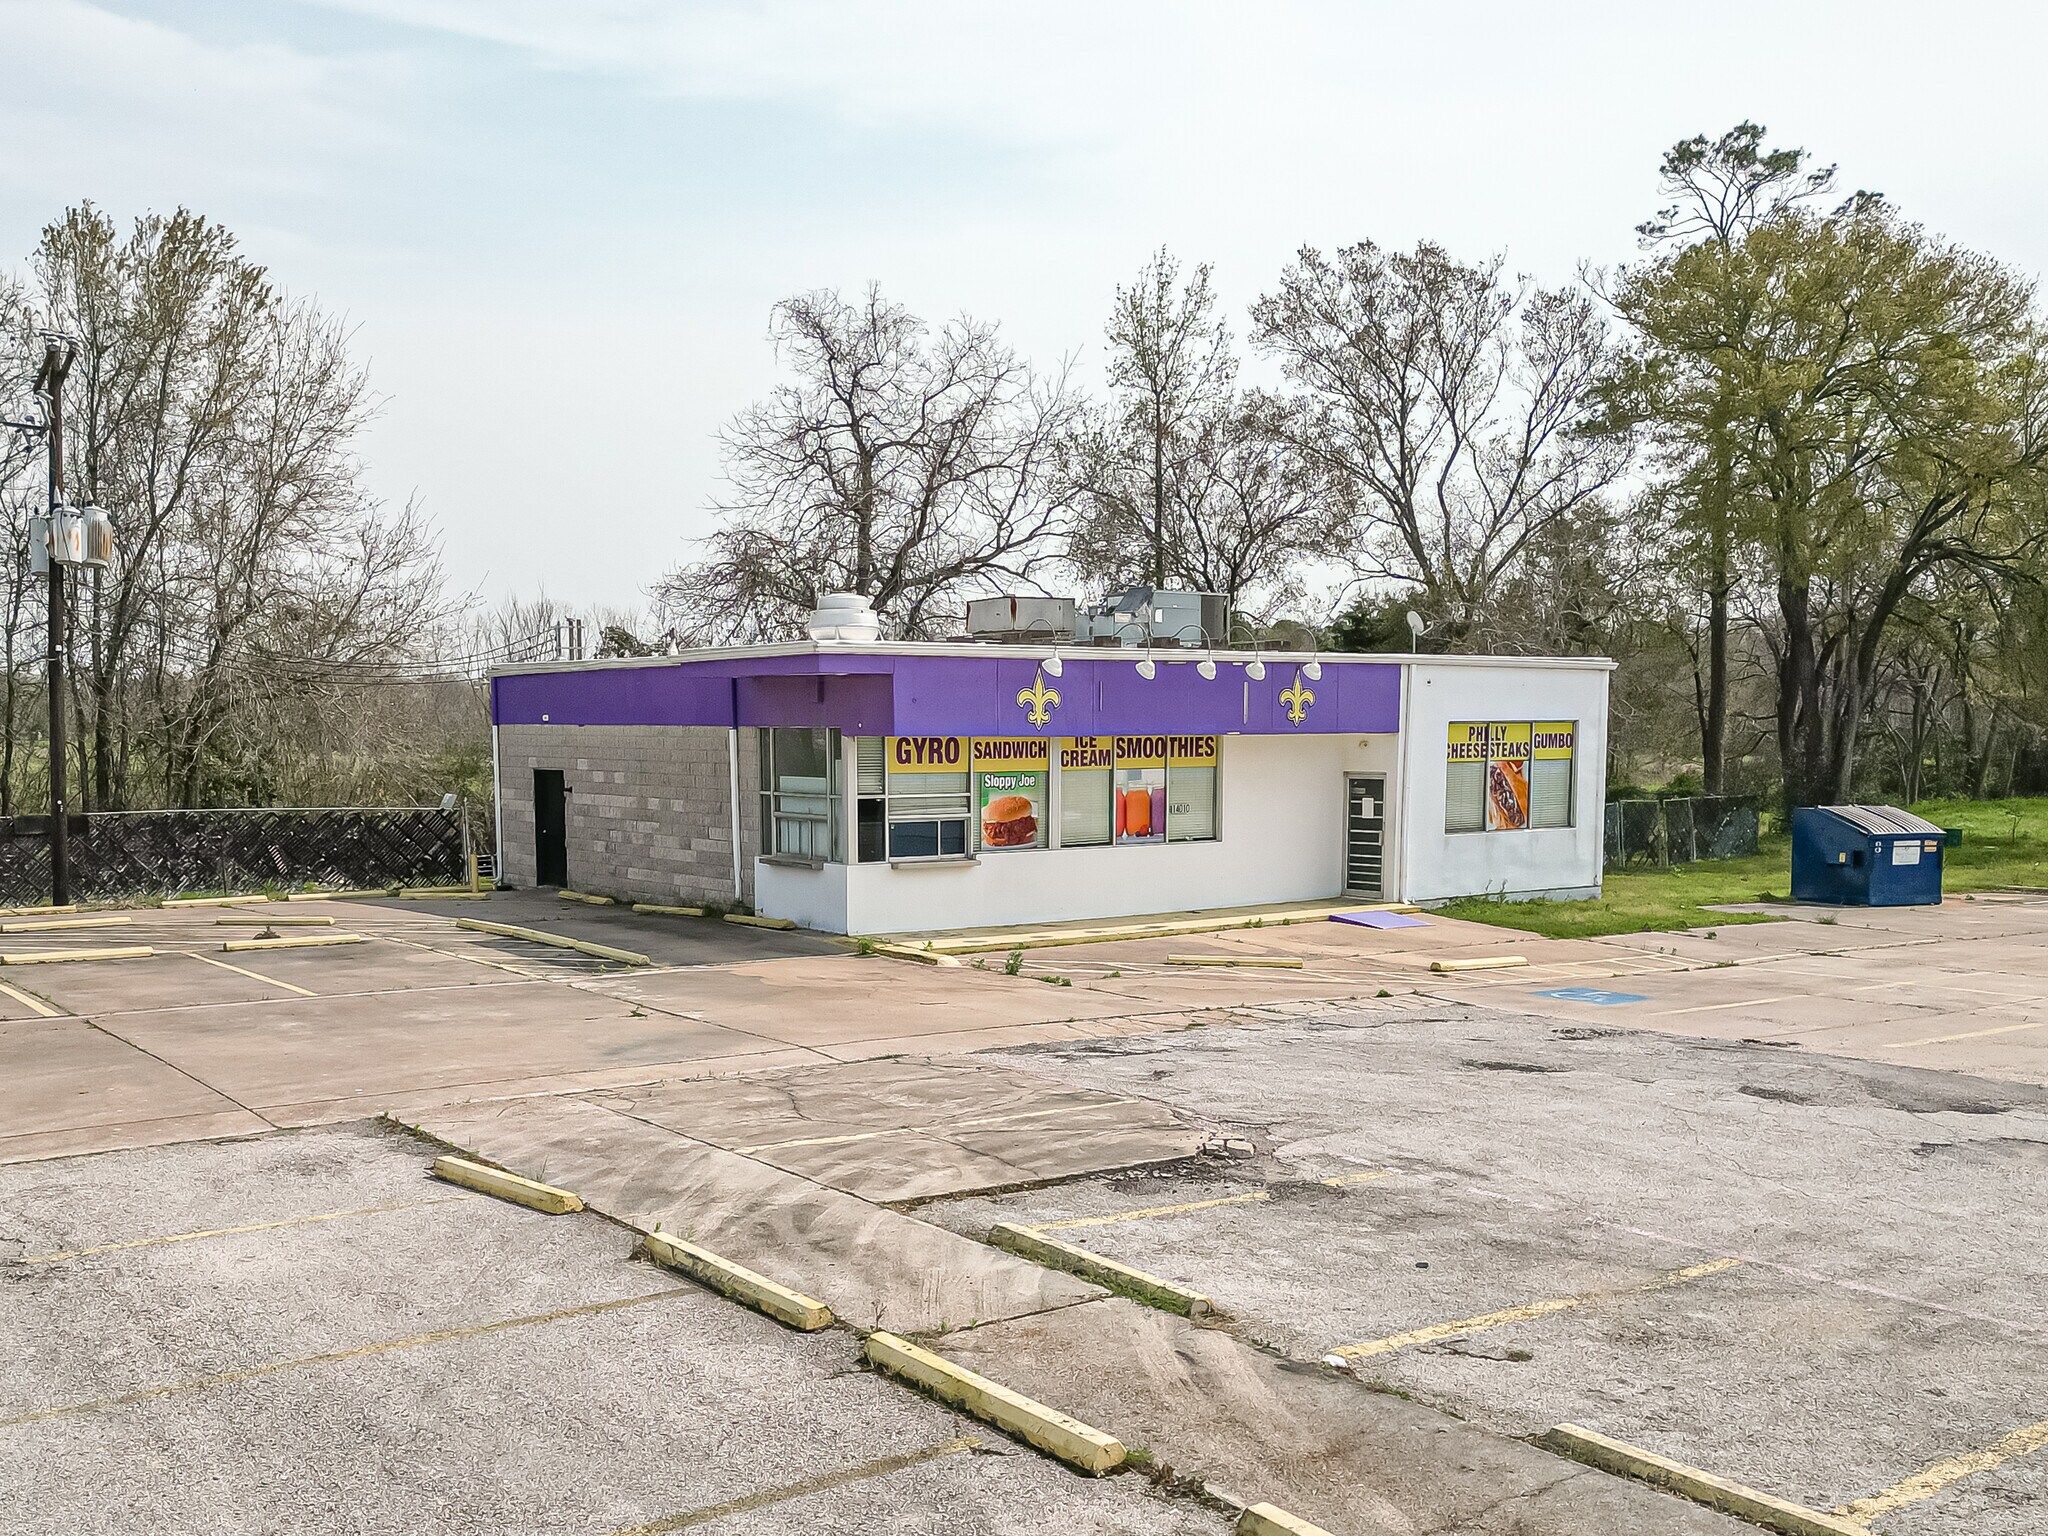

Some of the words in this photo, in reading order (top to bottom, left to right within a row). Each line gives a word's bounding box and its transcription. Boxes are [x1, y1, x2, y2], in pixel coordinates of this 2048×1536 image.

[1075, 736, 1098, 749] ICE
[1534, 733, 1573, 749] GUMBO
[896, 737, 960, 764] GYRO
[973, 741, 1047, 760] SANDWICH
[1060, 749, 1111, 767] CREAM
[984, 774, 1016, 790] Sloppy
[1018, 774, 1036, 787] Joe
